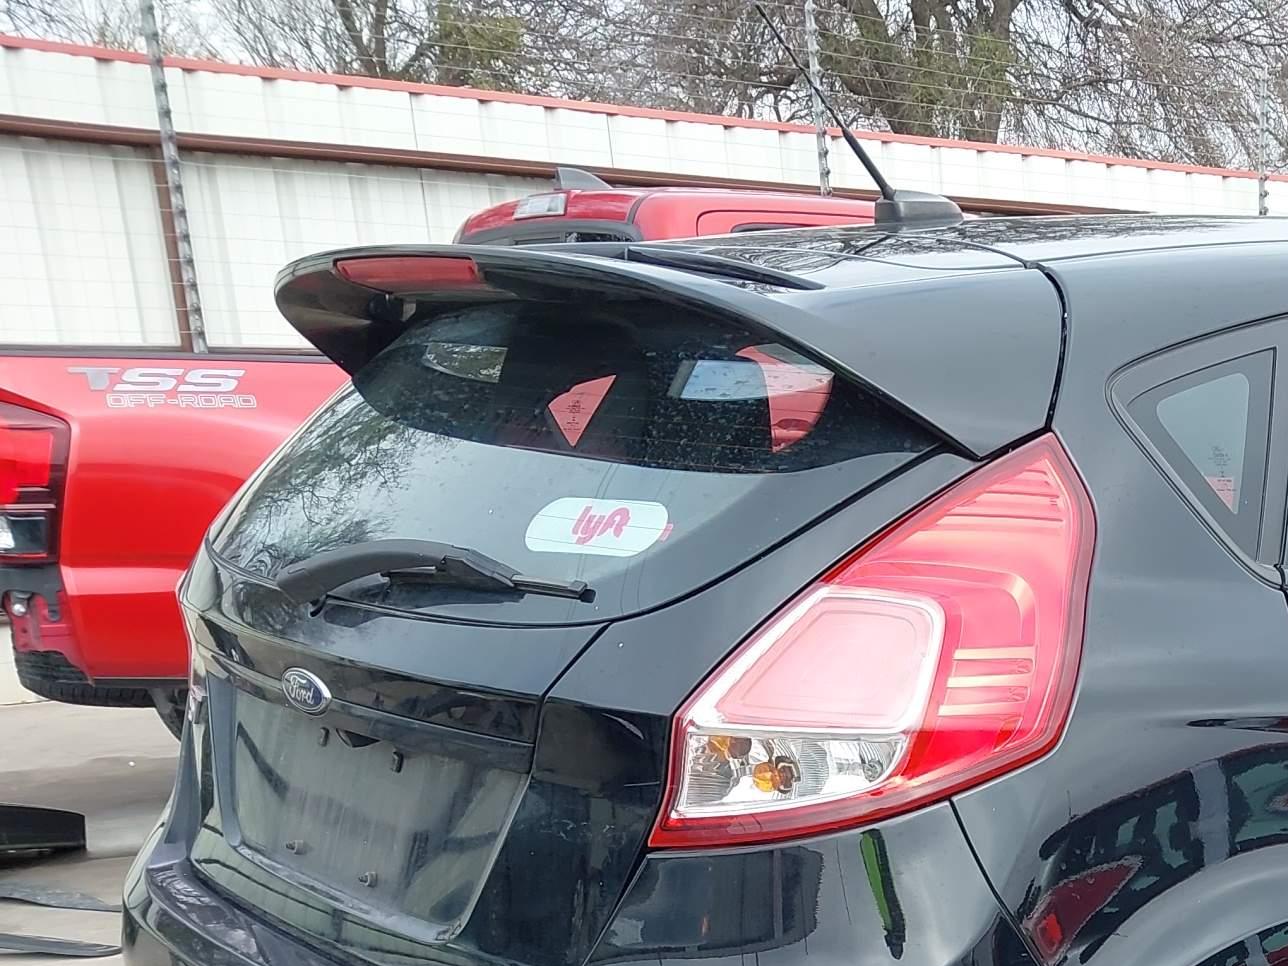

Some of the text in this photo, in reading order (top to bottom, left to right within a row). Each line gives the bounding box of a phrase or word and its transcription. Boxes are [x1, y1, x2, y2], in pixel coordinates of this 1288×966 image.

[66, 366, 246, 393] TSS
[106, 394, 257, 409] OFF-ROAD
[571, 505, 631, 546] lyft
